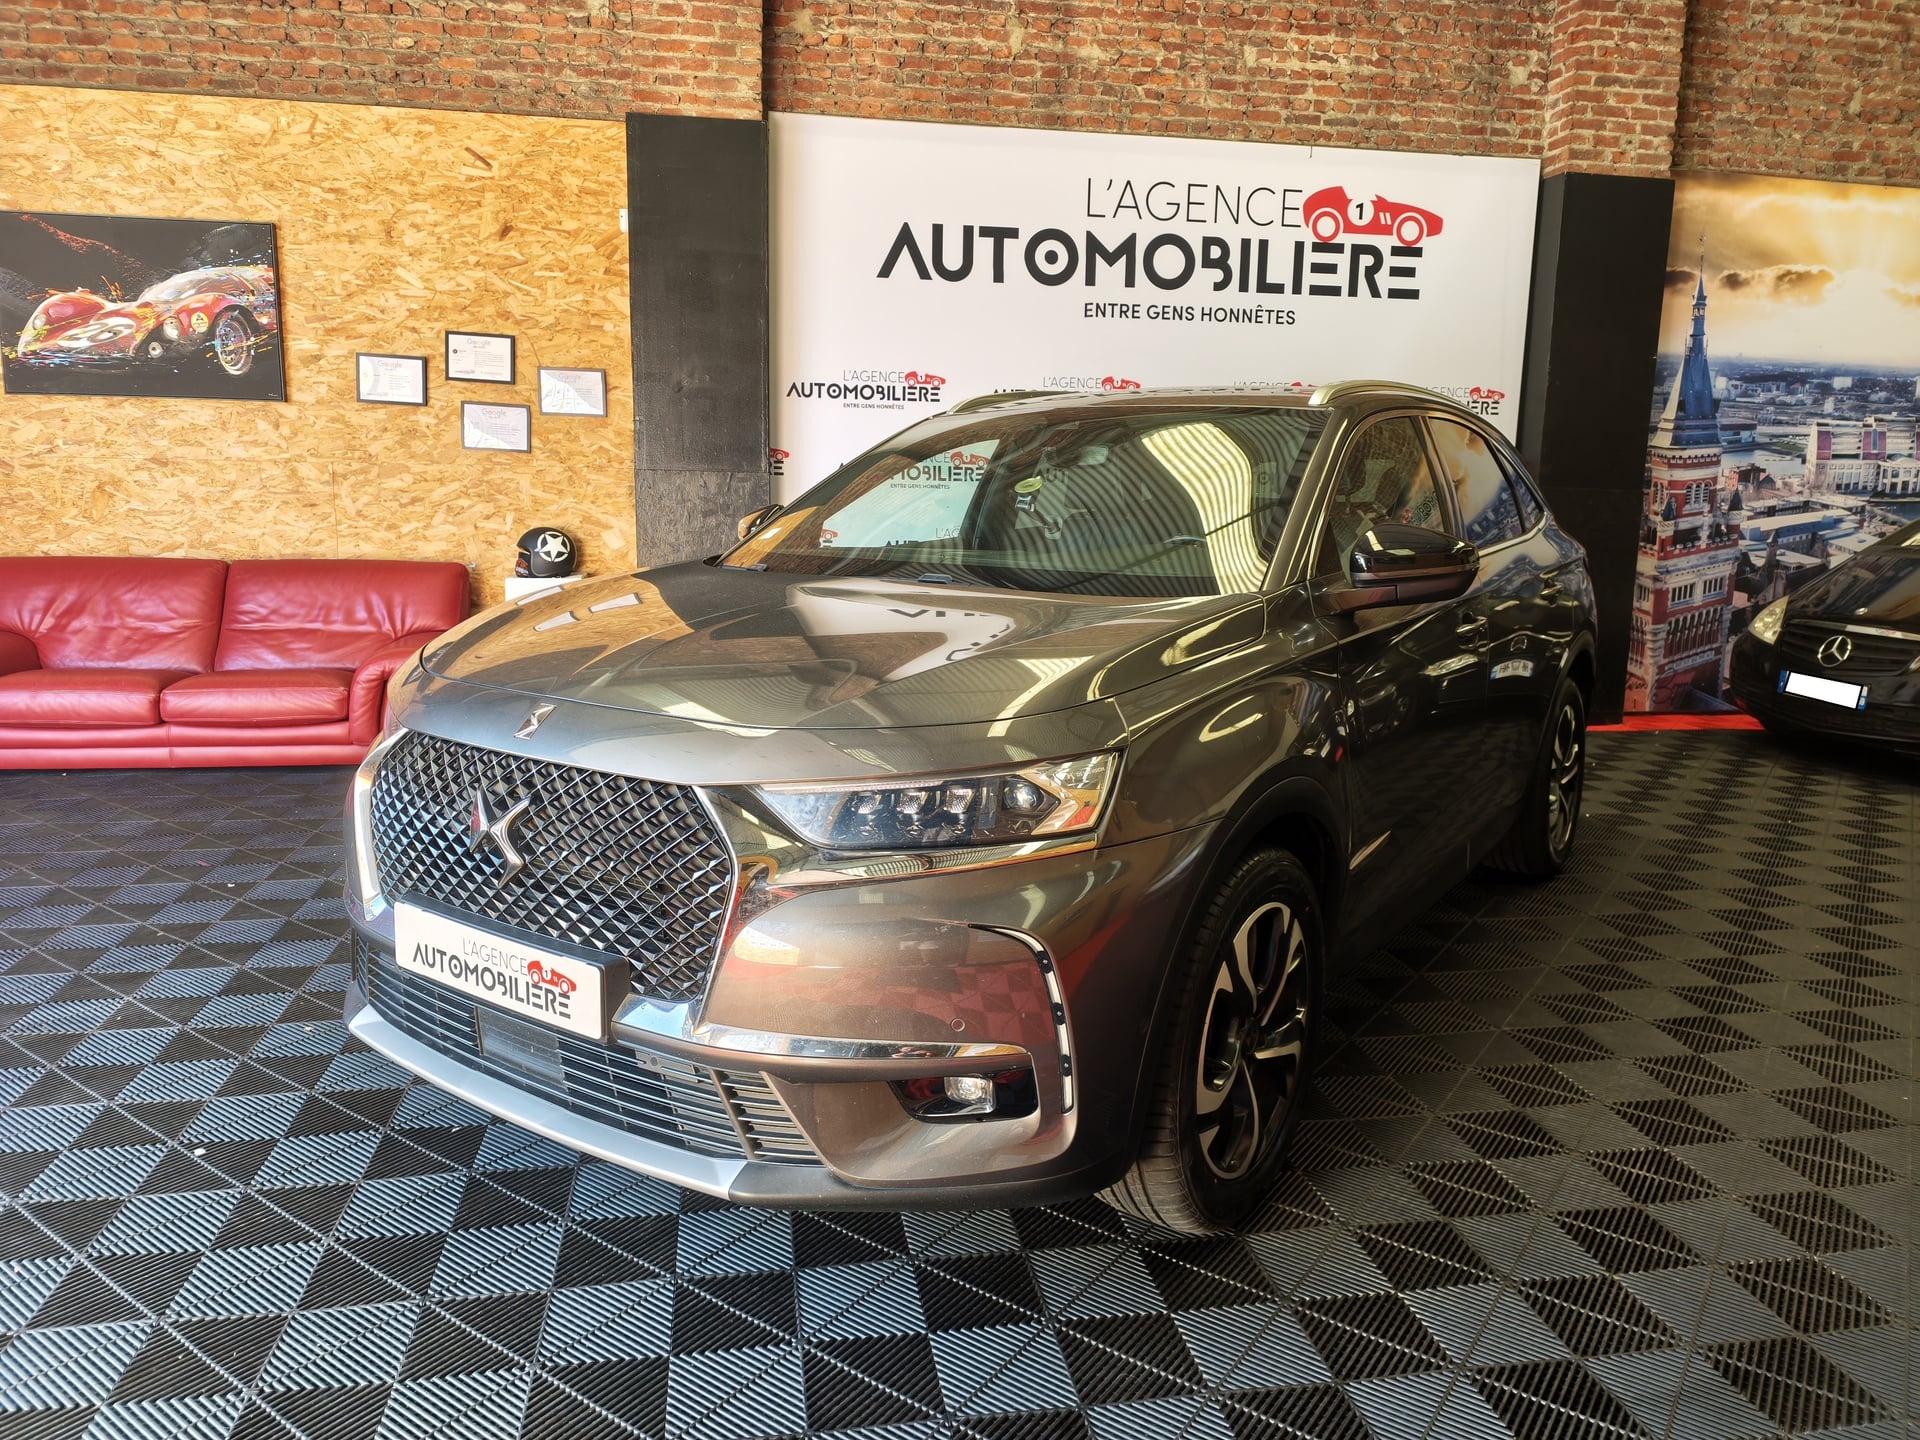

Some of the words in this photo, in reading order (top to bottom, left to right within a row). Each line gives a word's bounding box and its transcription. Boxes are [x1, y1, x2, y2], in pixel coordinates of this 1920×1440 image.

[1086, 177, 1303, 229] L'AGENCE
[1083, 302, 1141, 319] ENTRE
[1144, 304, 1197, 322] GENS
[1200, 304, 1297, 326] HONNÊTES
[843, 369, 905, 384] L'AGENCE
[1043, 376, 1102, 390] L'AGENCE
[462, 937, 529, 976] L'AGENCE
